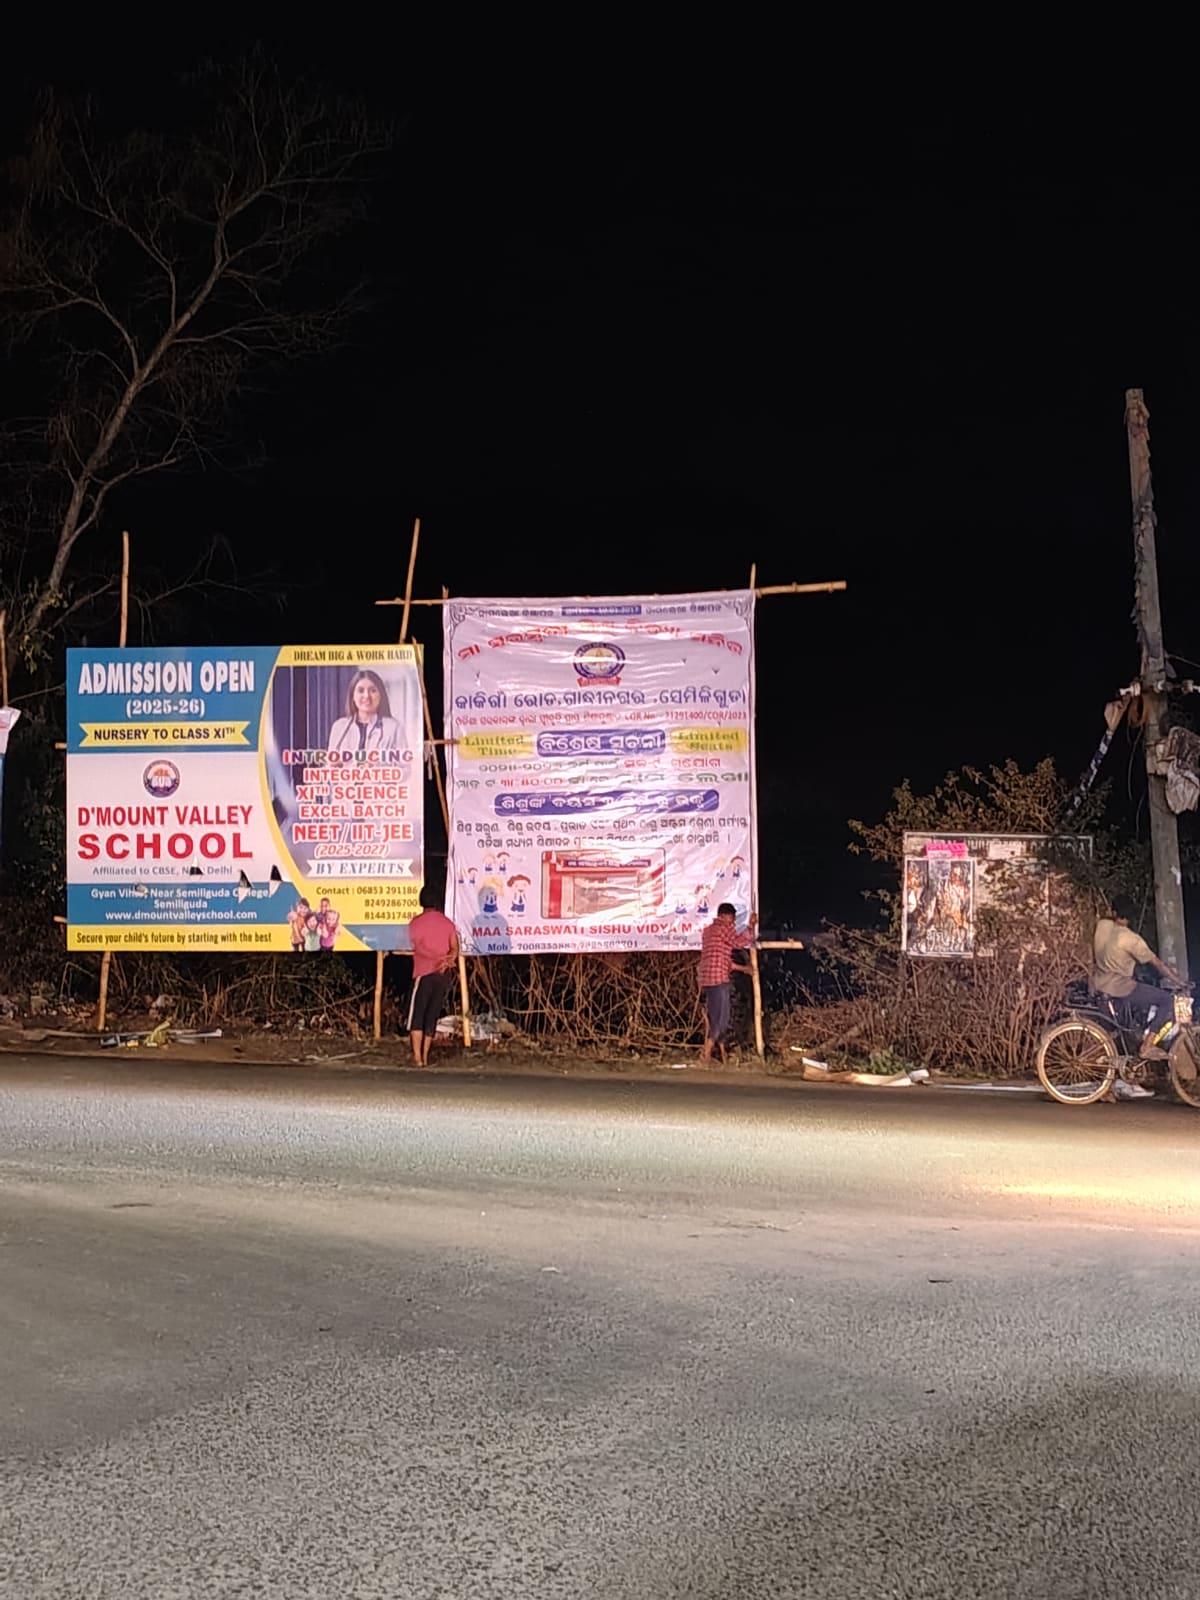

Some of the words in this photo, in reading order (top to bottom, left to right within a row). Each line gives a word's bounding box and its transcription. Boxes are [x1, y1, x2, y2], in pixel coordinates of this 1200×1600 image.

[294, 650, 326, 661] DREAM
[328, 650, 345, 661] BIG
[346, 650, 353, 660] &
[357, 650, 385, 660] WORK
[387, 650, 412, 660] HARD
[78, 661, 193, 695] ADMISSION
[200, 659, 255, 693] OPEN
[126, 698, 205, 718] (2025-26)
[94, 729, 149, 741] NURSERY
[152, 729, 169, 740] TO
[172, 728, 210, 740] CLASS
[679, 731, 739, 741] Limited
[284, 750, 413, 763] INTRODUCING
[304, 769, 401, 782] INTEGRATED
[334, 786, 409, 800] SCIENCE
[78, 806, 168, 827] D'MOUNT
[175, 805, 253, 826] VALLEY
[301, 805, 349, 817] EXCEL
[354, 805, 405, 817] BATCH
[78, 833, 253, 859] SCHOOL
[315, 844, 389, 858] (2025-2027)
[93, 867, 136, 877] Affiliated
[139, 867, 149, 876] to
[152, 866, 179, 877] CBSE,
[207, 866, 232, 876] Delhi
[316, 863, 333, 877] BY
[340, 862, 405, 876] EXPERTS
[91, 889, 116, 900] Gyan
[150, 889, 174, 898] Near
[176, 888, 230, 900] Semiliguda
[316, 886, 350, 896] Contact
[356, 885, 384, 895] 06853
[386, 885, 418, 895] 291186
[154, 900, 208, 910] Semiliguda
[364, 899, 418, 908] 8249286700
[105, 911, 257, 923] www.dmountvalleyschool.com
[472, 925, 501, 937] MAA
[505, 922, 584, 937] SARASWATI
[589, 922, 632, 936] SISHU
[77, 932, 103, 944] Secure
[105, 934, 121, 945] your
[124, 932, 149, 943] child's
[151, 932, 175, 943] future
[177, 932, 185, 945] by
[188, 932, 219, 945] starting
[221, 931, 237, 942] with
[240, 931, 252, 942] the
[255, 931, 271, 942] best
[487, 943, 509, 952] Mob
